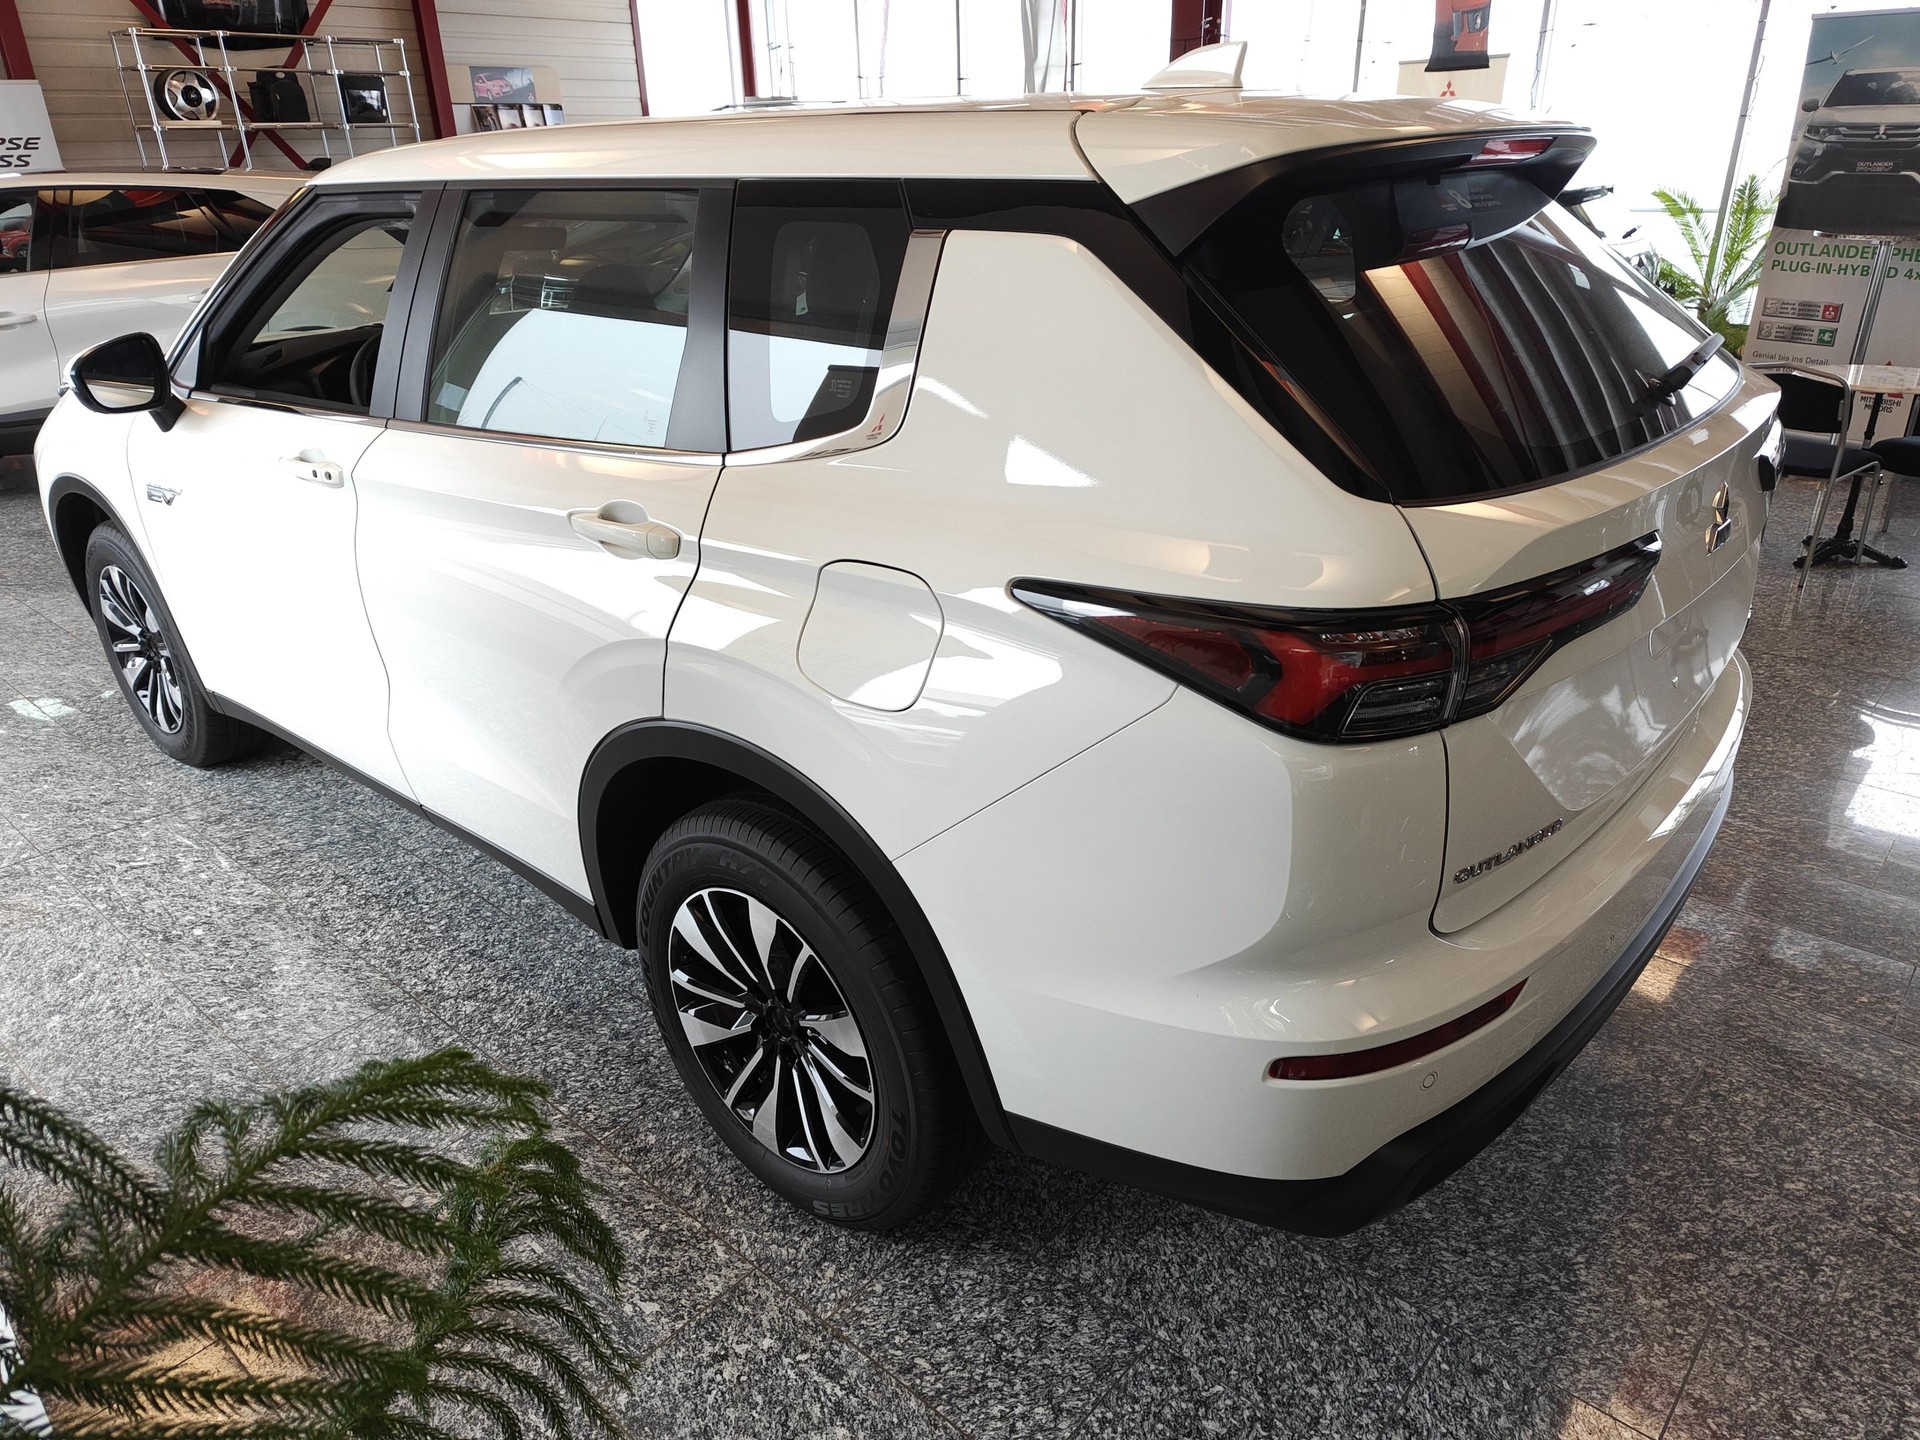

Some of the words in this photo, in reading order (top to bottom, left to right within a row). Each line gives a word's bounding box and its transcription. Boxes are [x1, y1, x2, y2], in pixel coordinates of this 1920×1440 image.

[0, 137, 41, 150] PSE
[1771, 259, 1899, 278] PLUG-IN-HYBD
[1752, 350, 1777, 360] Genial
[1778, 353, 1790, 361] bis
[1791, 354, 1804, 363] ins
[1860, 395, 1902, 407] MITSBISHI
[1863, 403, 1893, 414] MOORS
[1453, 818, 1563, 884] OUTLANDER
[639, 846, 701, 948] COUNTRY
[879, 1108, 909, 1194] TOYO
[812, 1188, 887, 1218] TIRES
